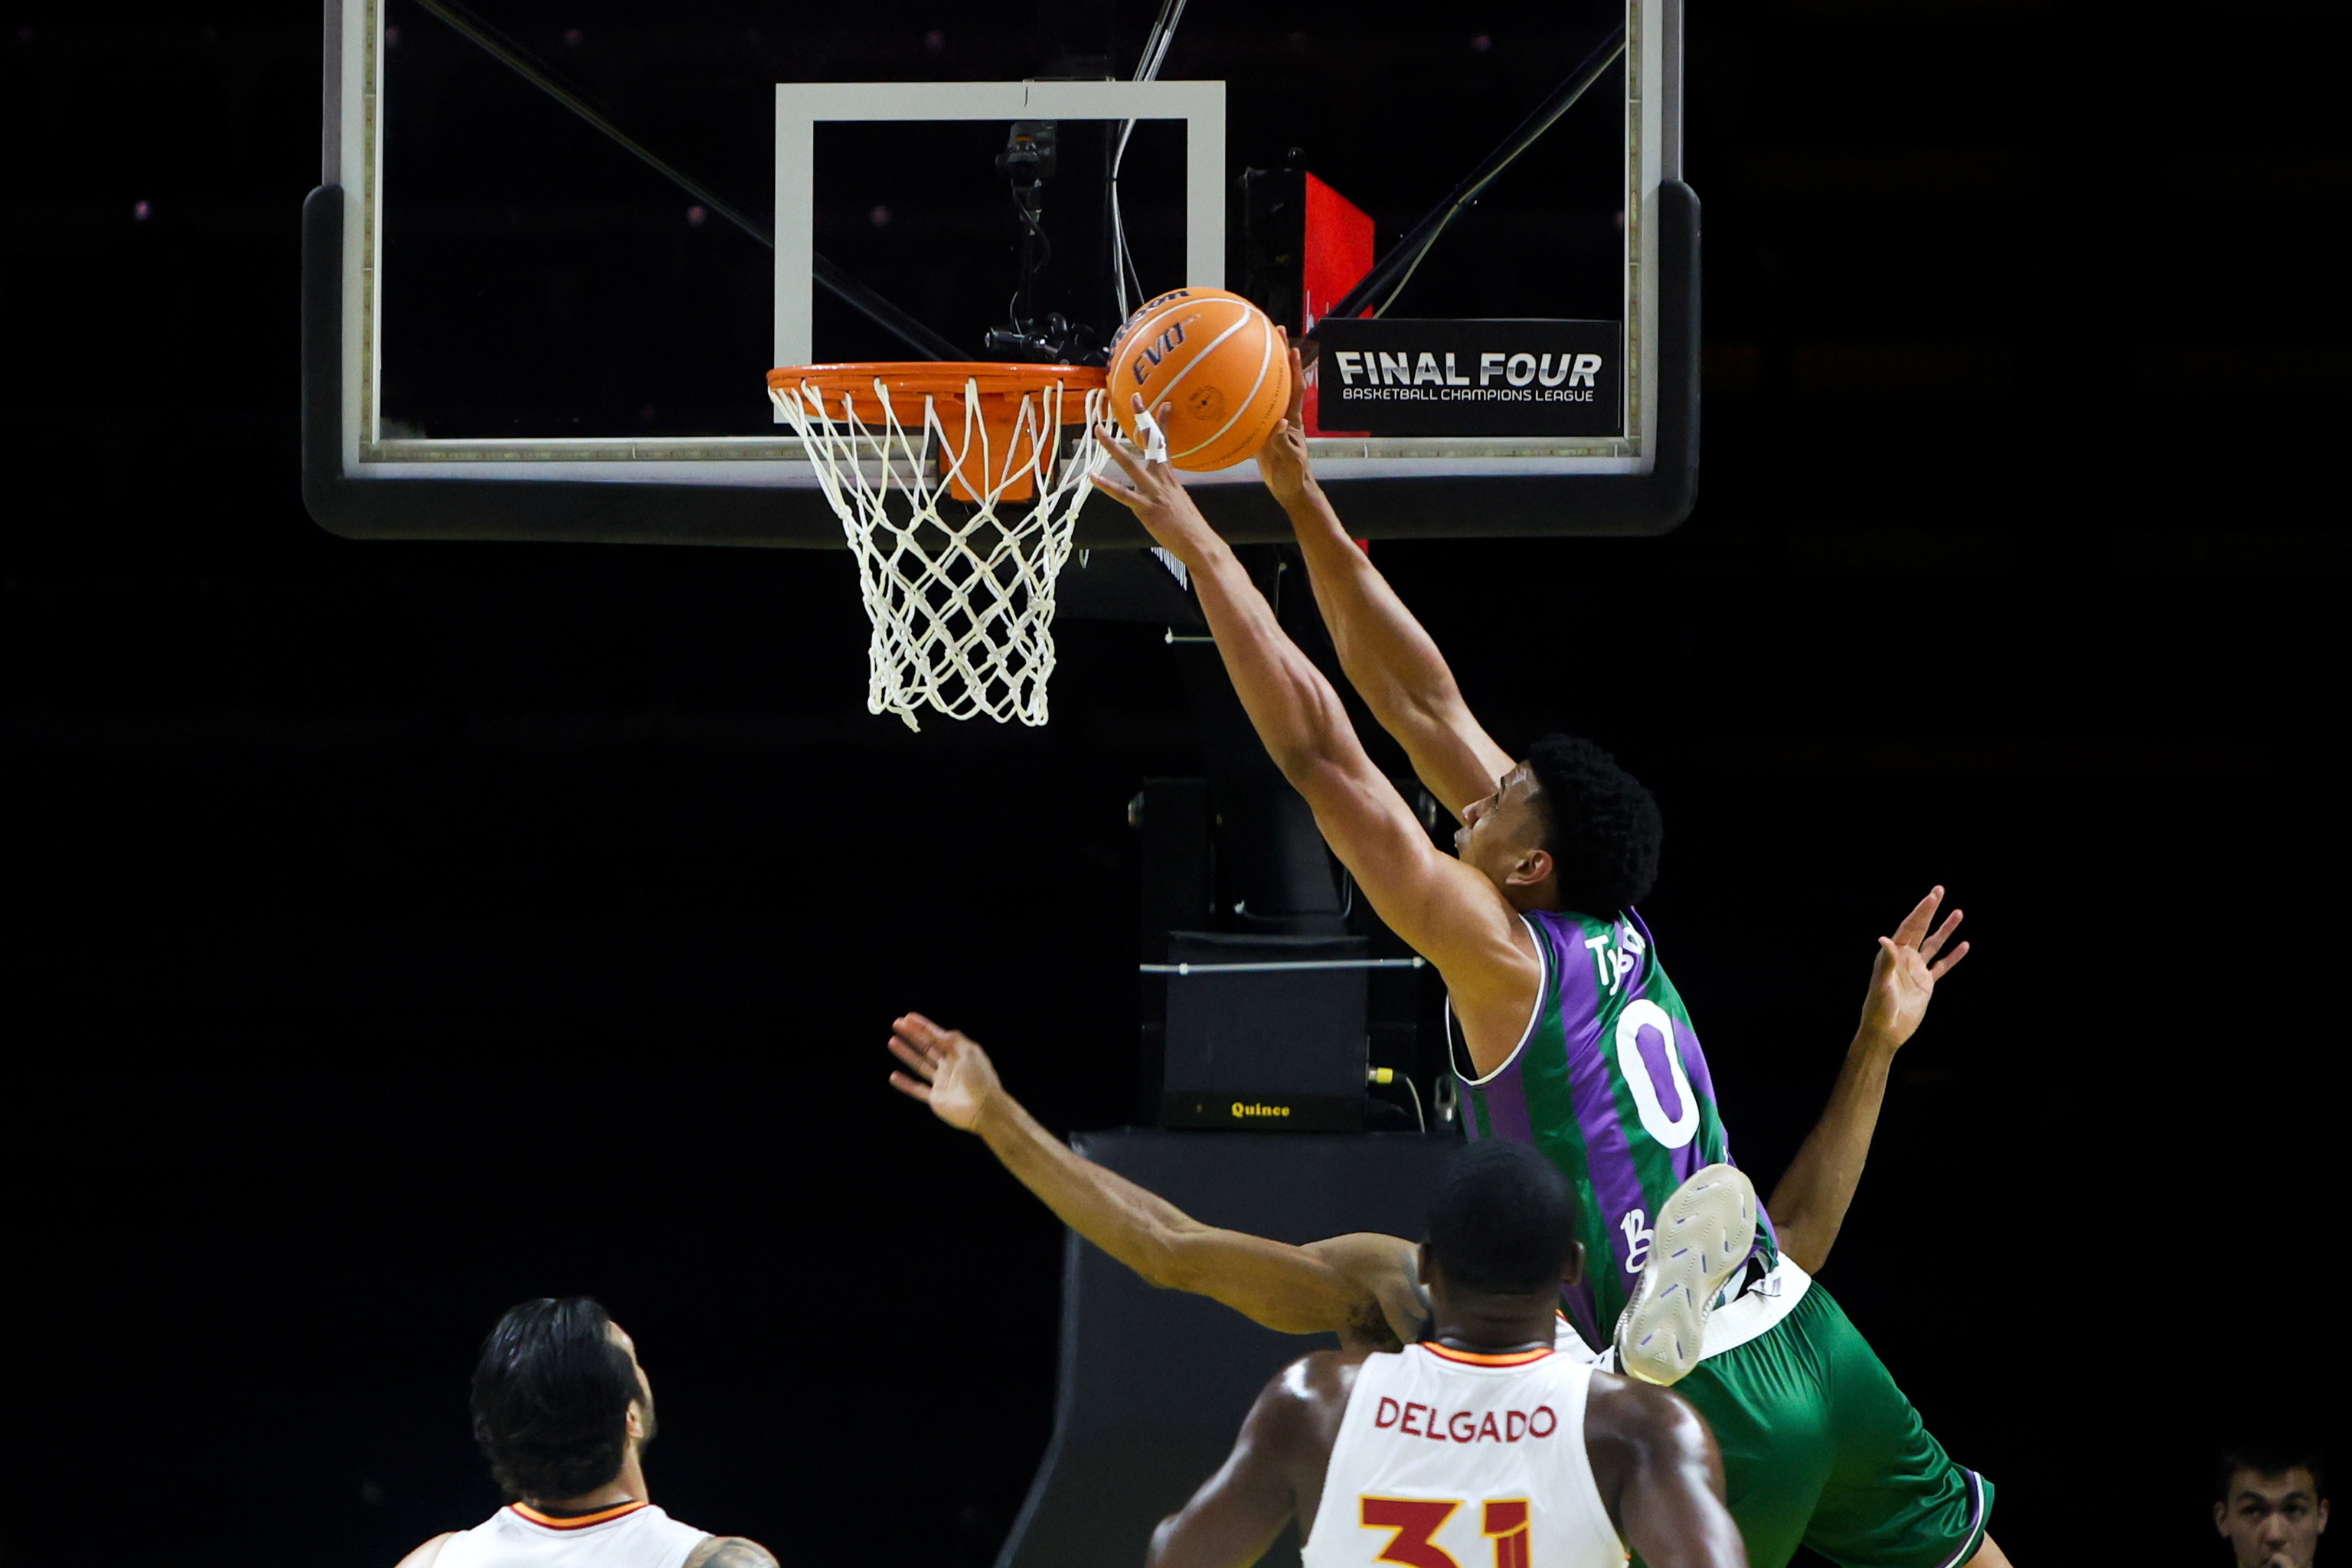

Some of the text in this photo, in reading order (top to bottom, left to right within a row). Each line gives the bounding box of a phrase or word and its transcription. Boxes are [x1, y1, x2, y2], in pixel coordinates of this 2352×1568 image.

[1133, 322, 1186, 385] EVO
[1335, 351, 1470, 386] FINAL
[1480, 352, 1602, 387] FOUR
[1343, 387, 1594, 403] BASKETBALL CHAMPIONS LEAGUE
[1615, 998, 1700, 1149] 0
[1231, 1101, 1290, 1119] Quince
[1375, 1396, 1557, 1444] DELGADO
[1358, 1494, 1532, 1568] 31
